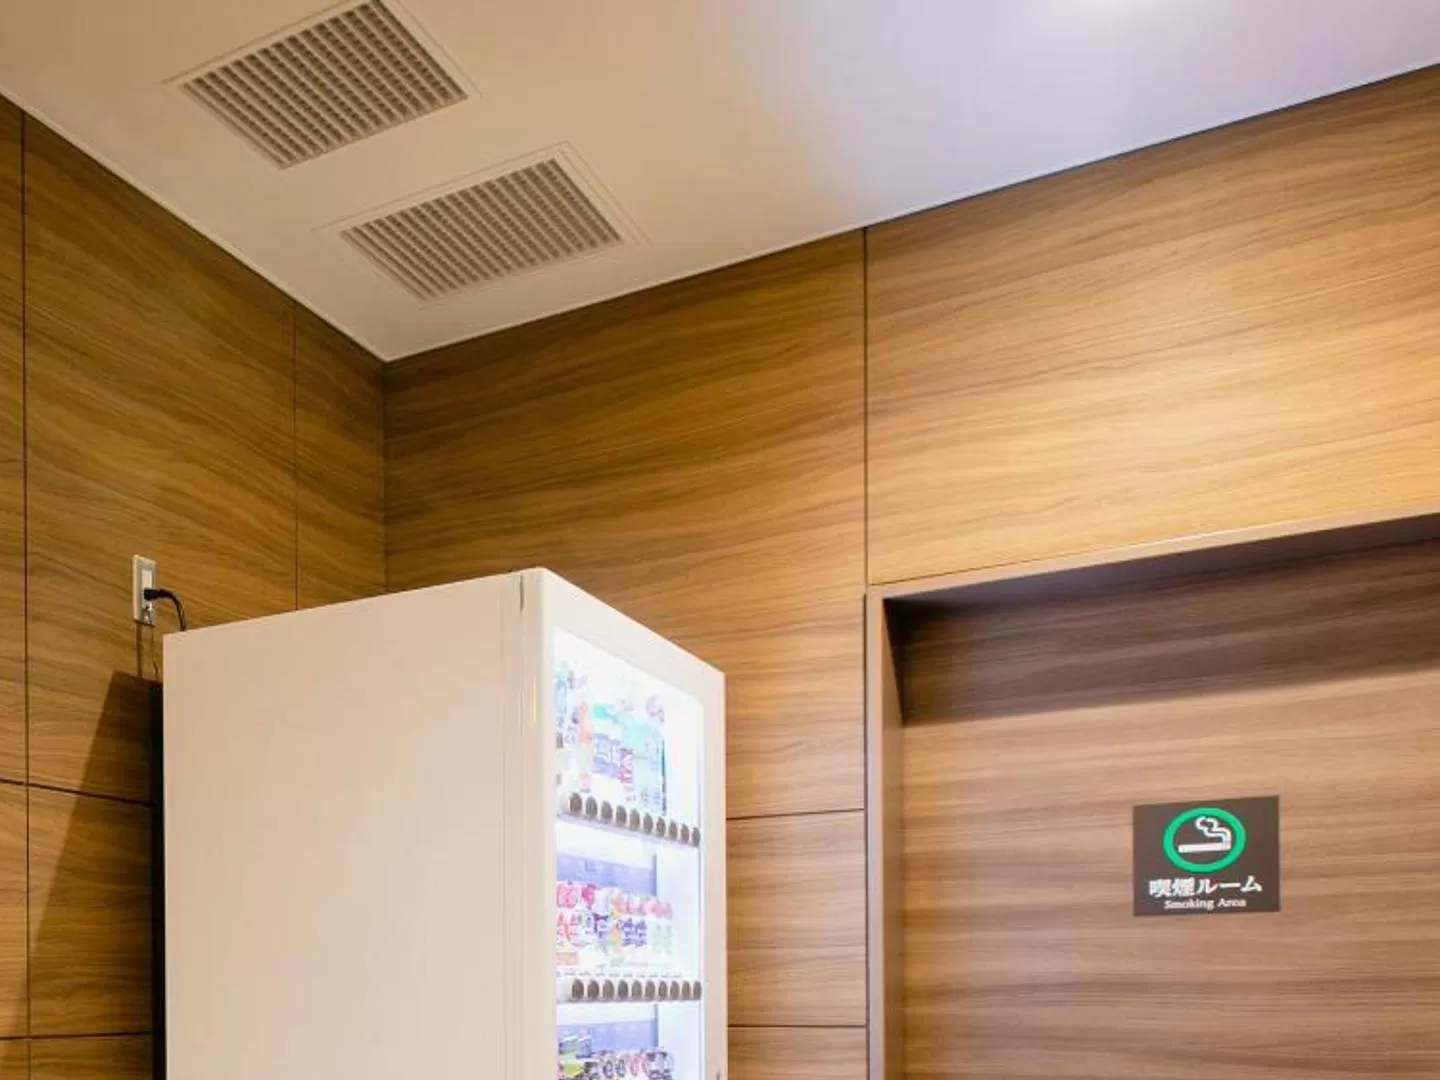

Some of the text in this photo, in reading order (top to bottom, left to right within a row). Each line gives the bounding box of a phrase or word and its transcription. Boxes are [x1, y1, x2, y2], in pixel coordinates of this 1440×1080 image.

[1148, 875, 1263, 898] 喫煙ルーム
[1164, 897, 1248, 910] Smoking Area
